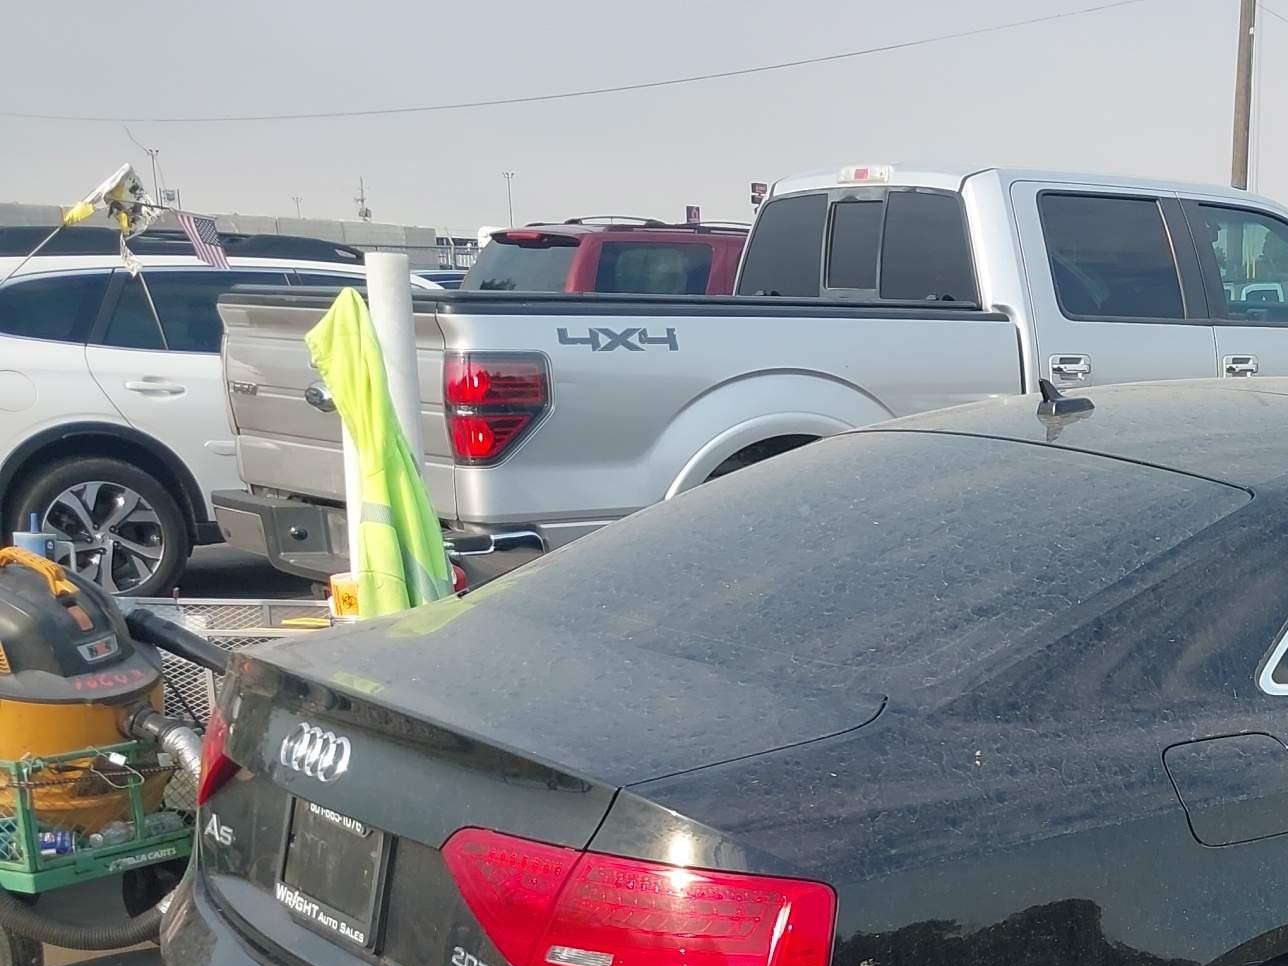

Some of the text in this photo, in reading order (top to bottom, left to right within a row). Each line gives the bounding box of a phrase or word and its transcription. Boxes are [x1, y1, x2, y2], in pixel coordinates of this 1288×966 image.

[203, 813, 233, 846] A5
[275, 882, 364, 943] WRIGHT AUTO SALES
